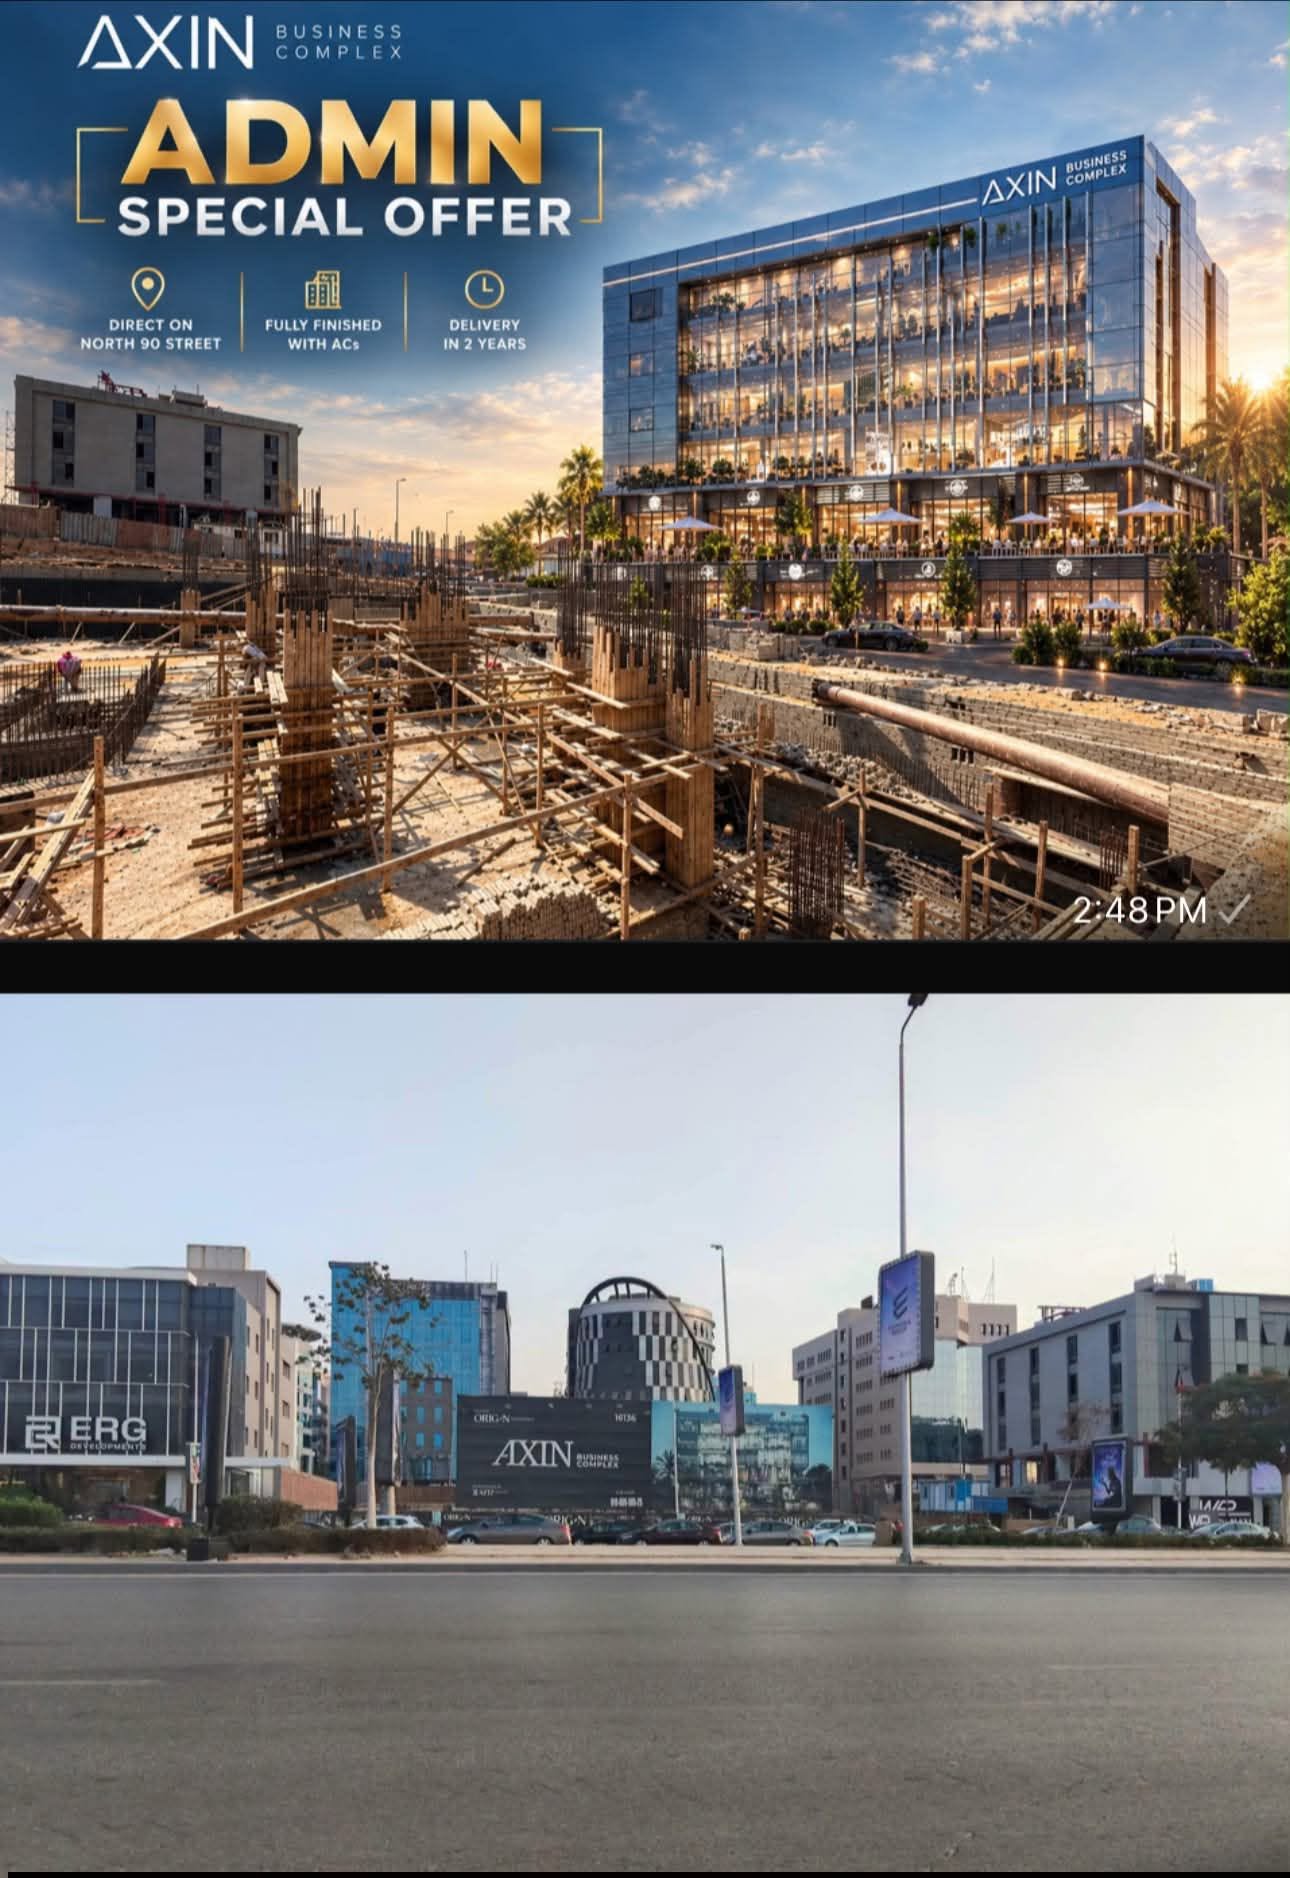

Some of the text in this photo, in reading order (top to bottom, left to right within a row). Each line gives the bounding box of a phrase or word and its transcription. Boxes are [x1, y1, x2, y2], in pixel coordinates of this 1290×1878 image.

[1065, 150, 1128, 173] BUSINESS
[982, 166, 1057, 206] AXIN
[1065, 163, 1128, 186] COMPLEX
[70, 1416, 146, 1442] ERG
[492, 1439, 574, 1468] AXIN
[576, 1453, 620, 1461] BUSINESS
[576, 1461, 619, 1469] COMPLEX
